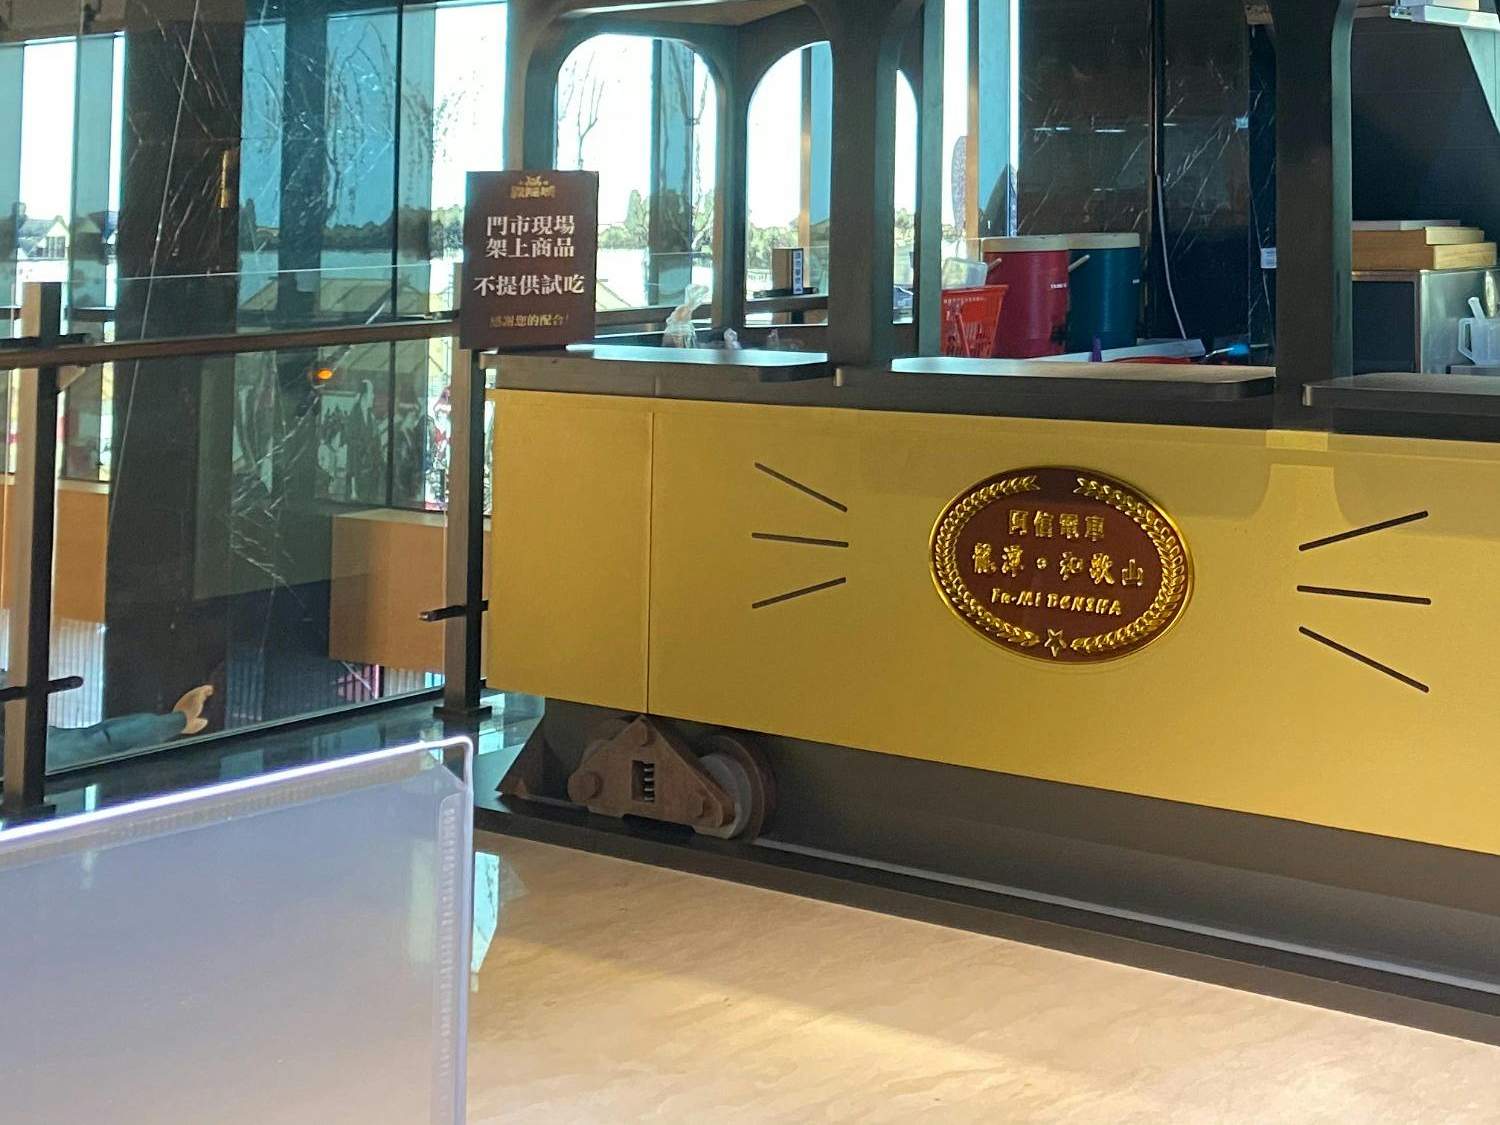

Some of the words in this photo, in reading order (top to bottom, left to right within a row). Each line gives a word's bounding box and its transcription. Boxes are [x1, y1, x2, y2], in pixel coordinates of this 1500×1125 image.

[486, 215, 576, 237] 門市現場
[485, 237, 575, 259] 架上商品
[473, 273, 585, 297] 不提供試吃
